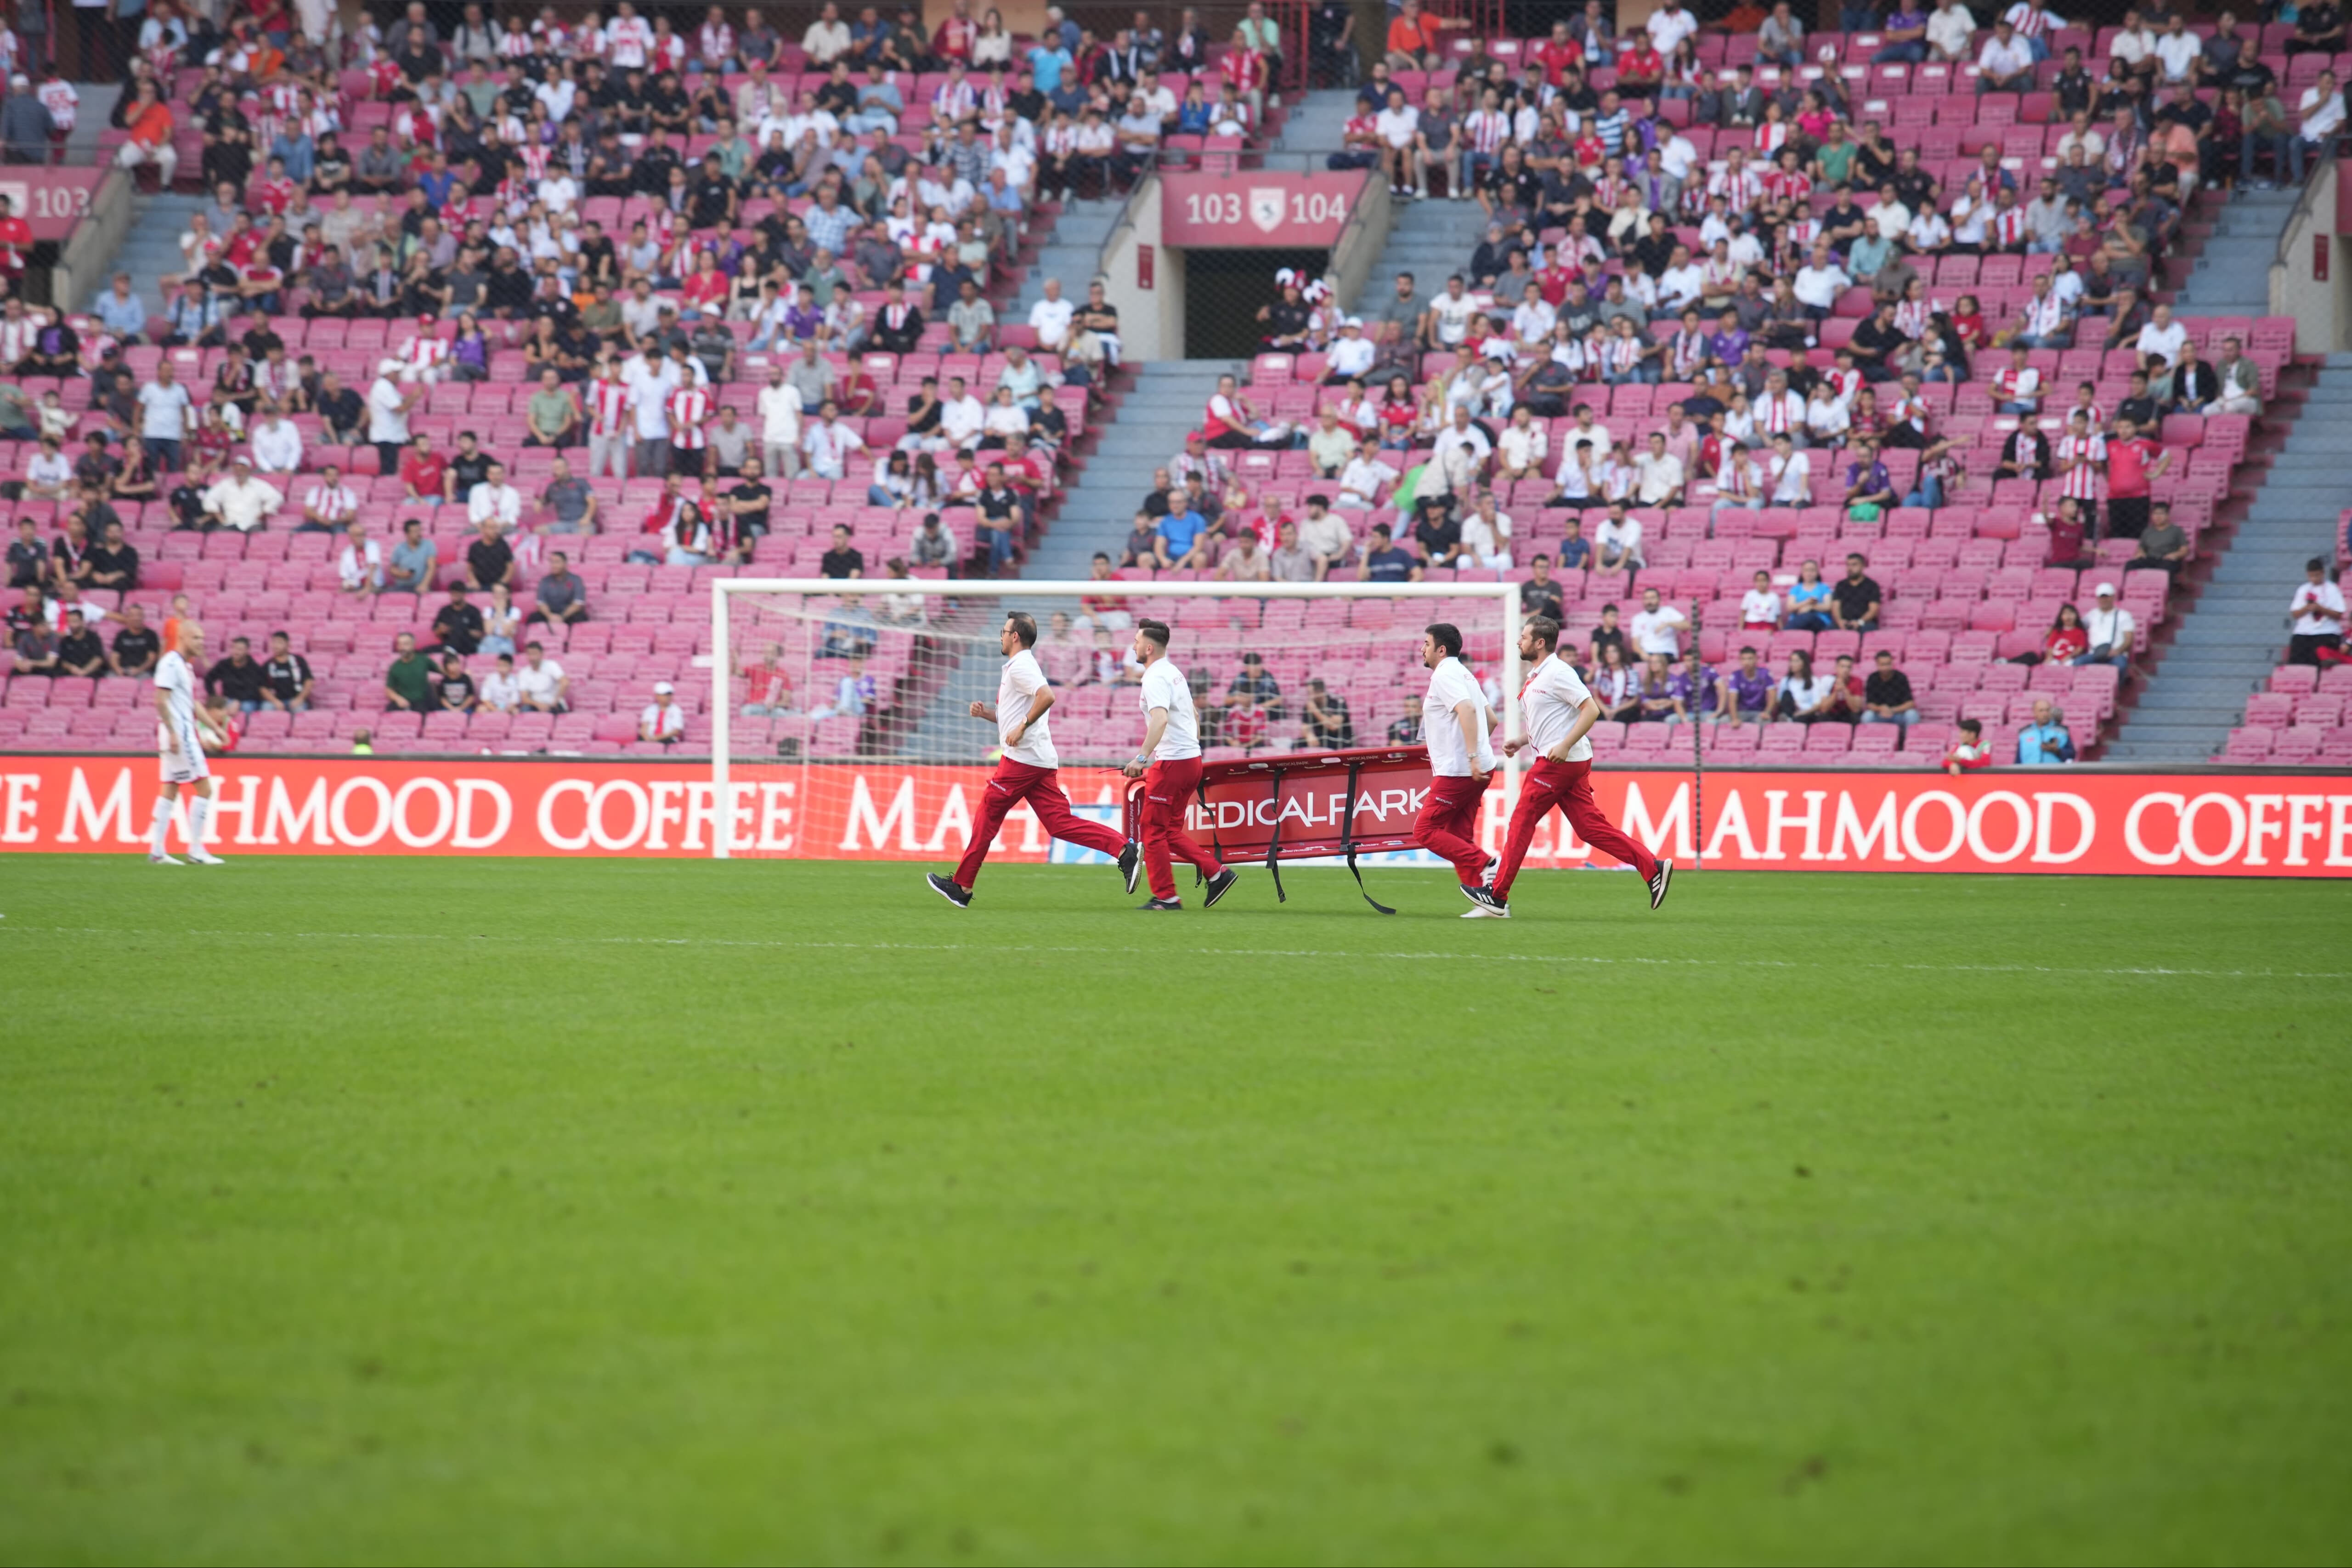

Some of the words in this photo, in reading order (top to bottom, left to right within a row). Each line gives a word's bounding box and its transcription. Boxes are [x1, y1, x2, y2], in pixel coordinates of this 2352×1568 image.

[35, 187, 90, 218] 103
[1186, 192, 1242, 224] 103
[1291, 192, 1346, 224] 104
[0, 774, 40, 843] E
[56, 767, 513, 849] MAHMOOD
[537, 779, 795, 851] COFFEE
[1621, 781, 2096, 864] MAHMOOD
[2124, 791, 2352, 867] COFFE
